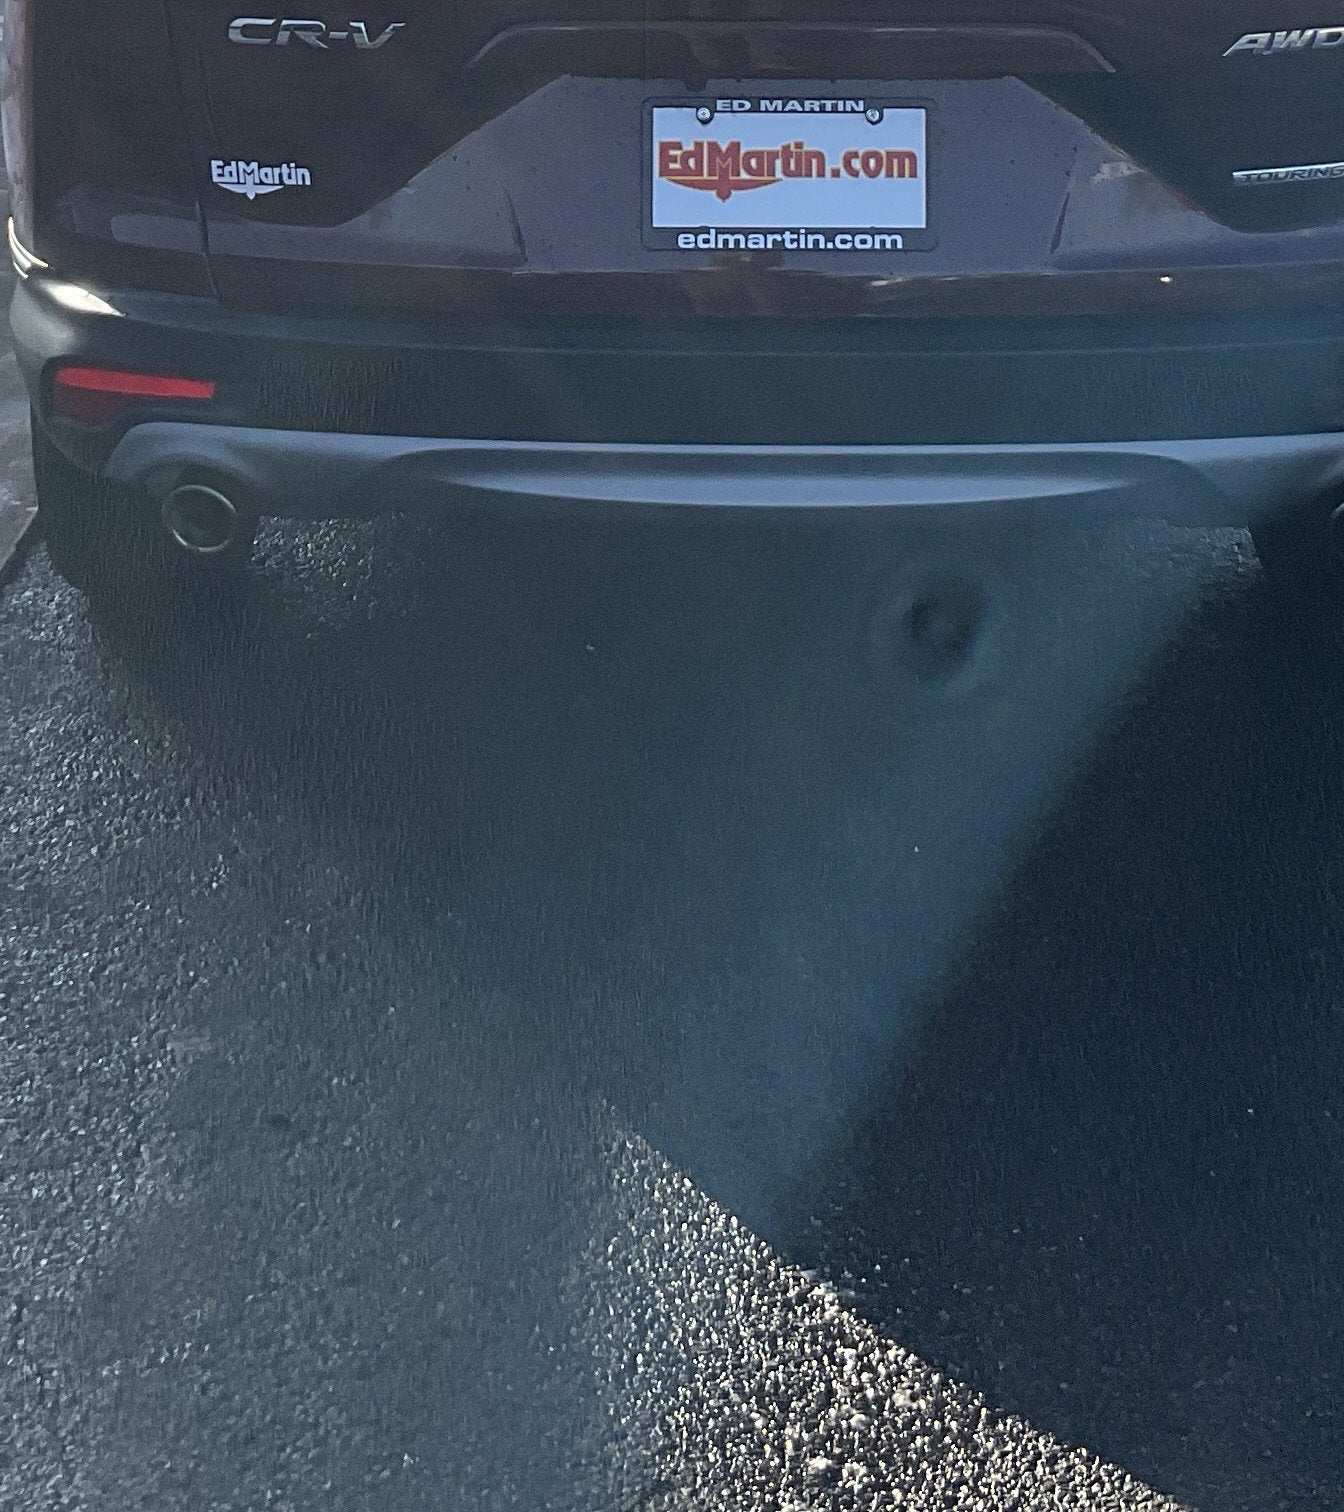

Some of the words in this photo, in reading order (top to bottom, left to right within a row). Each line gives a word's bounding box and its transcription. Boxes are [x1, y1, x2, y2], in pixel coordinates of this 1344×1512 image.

[228, 17, 406, 49] CR-V
[716, 99, 751, 112] ED
[760, 99, 864, 112] MARTIN
[211, 159, 311, 186] EdMartin
[658, 140, 918, 179] EdMartin.com
[677, 229, 904, 250] edmartin.com
